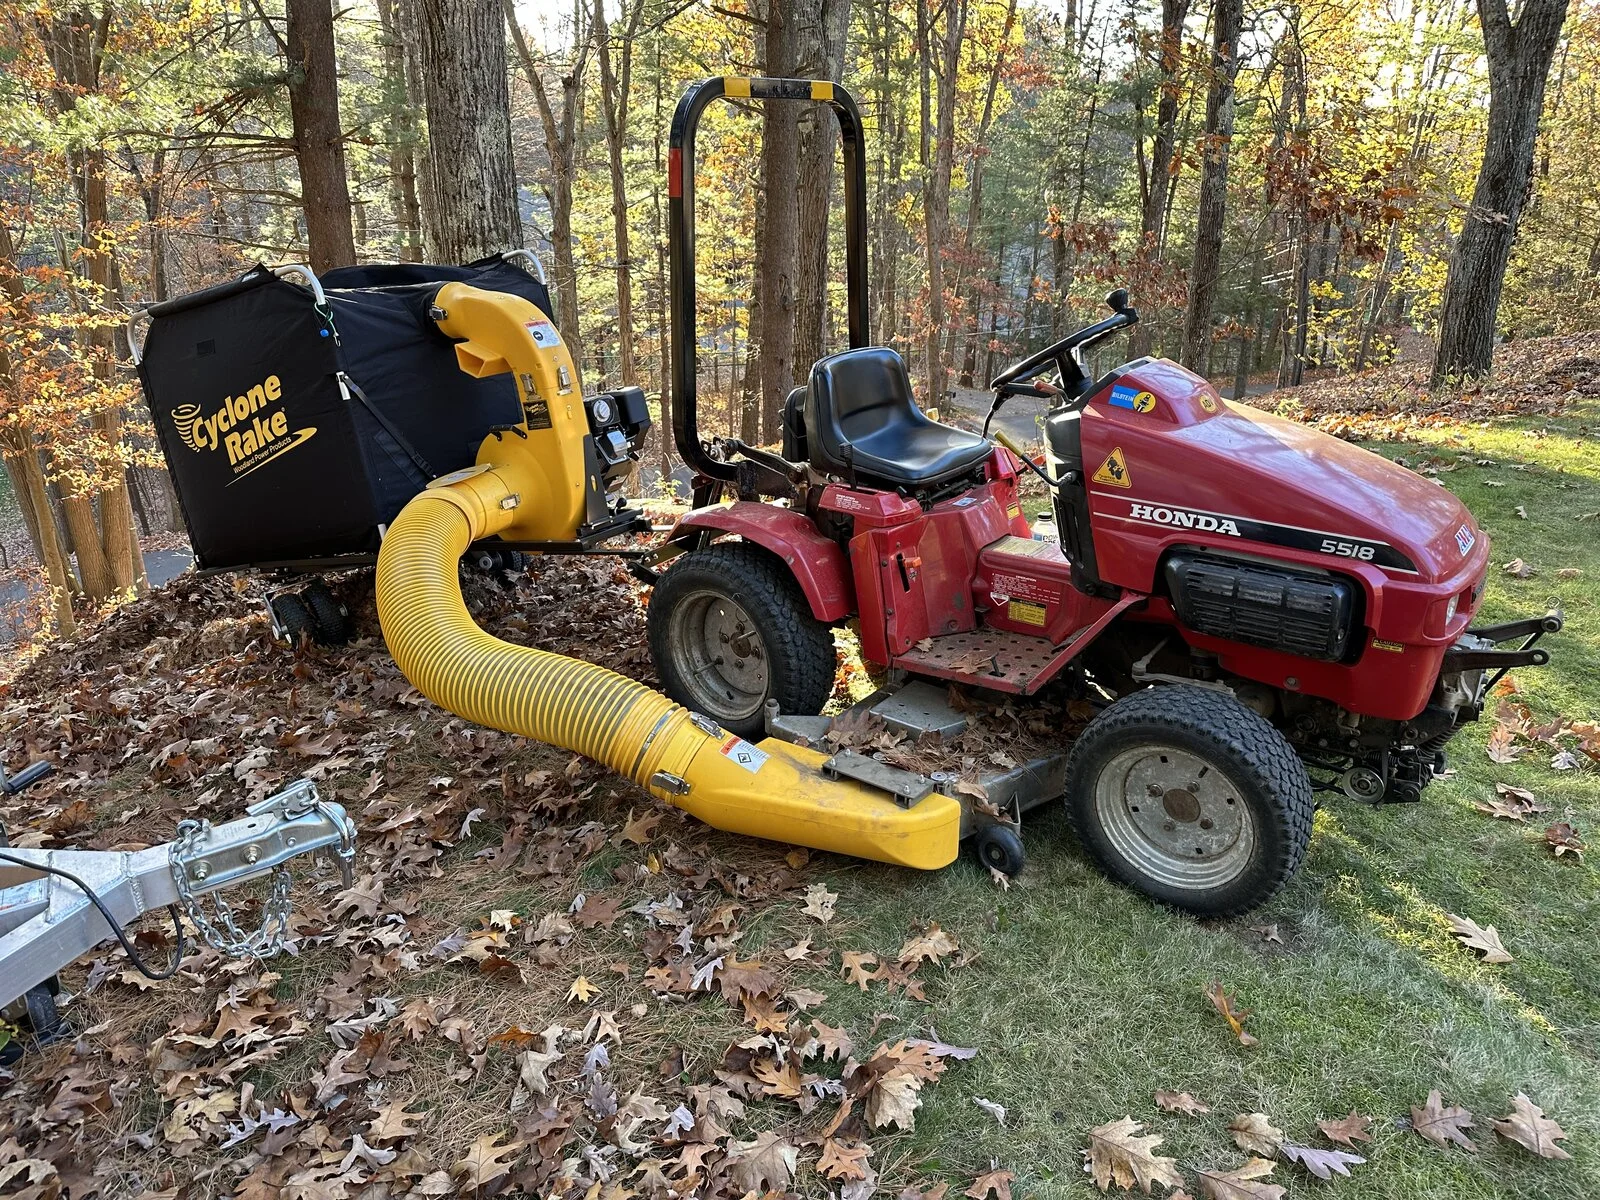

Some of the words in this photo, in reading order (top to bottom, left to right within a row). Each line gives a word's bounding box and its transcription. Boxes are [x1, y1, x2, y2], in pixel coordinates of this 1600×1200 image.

[192, 375, 282, 451] Cyclone
[1111, 391, 1134, 402] BILSTEIN
[233, 456, 255, 474] Woodland
[254, 449, 270, 462] Power
[269, 436, 292, 454] Products
[1129, 503, 1242, 537] HONDA
[1320, 539, 1375, 560] 5518
